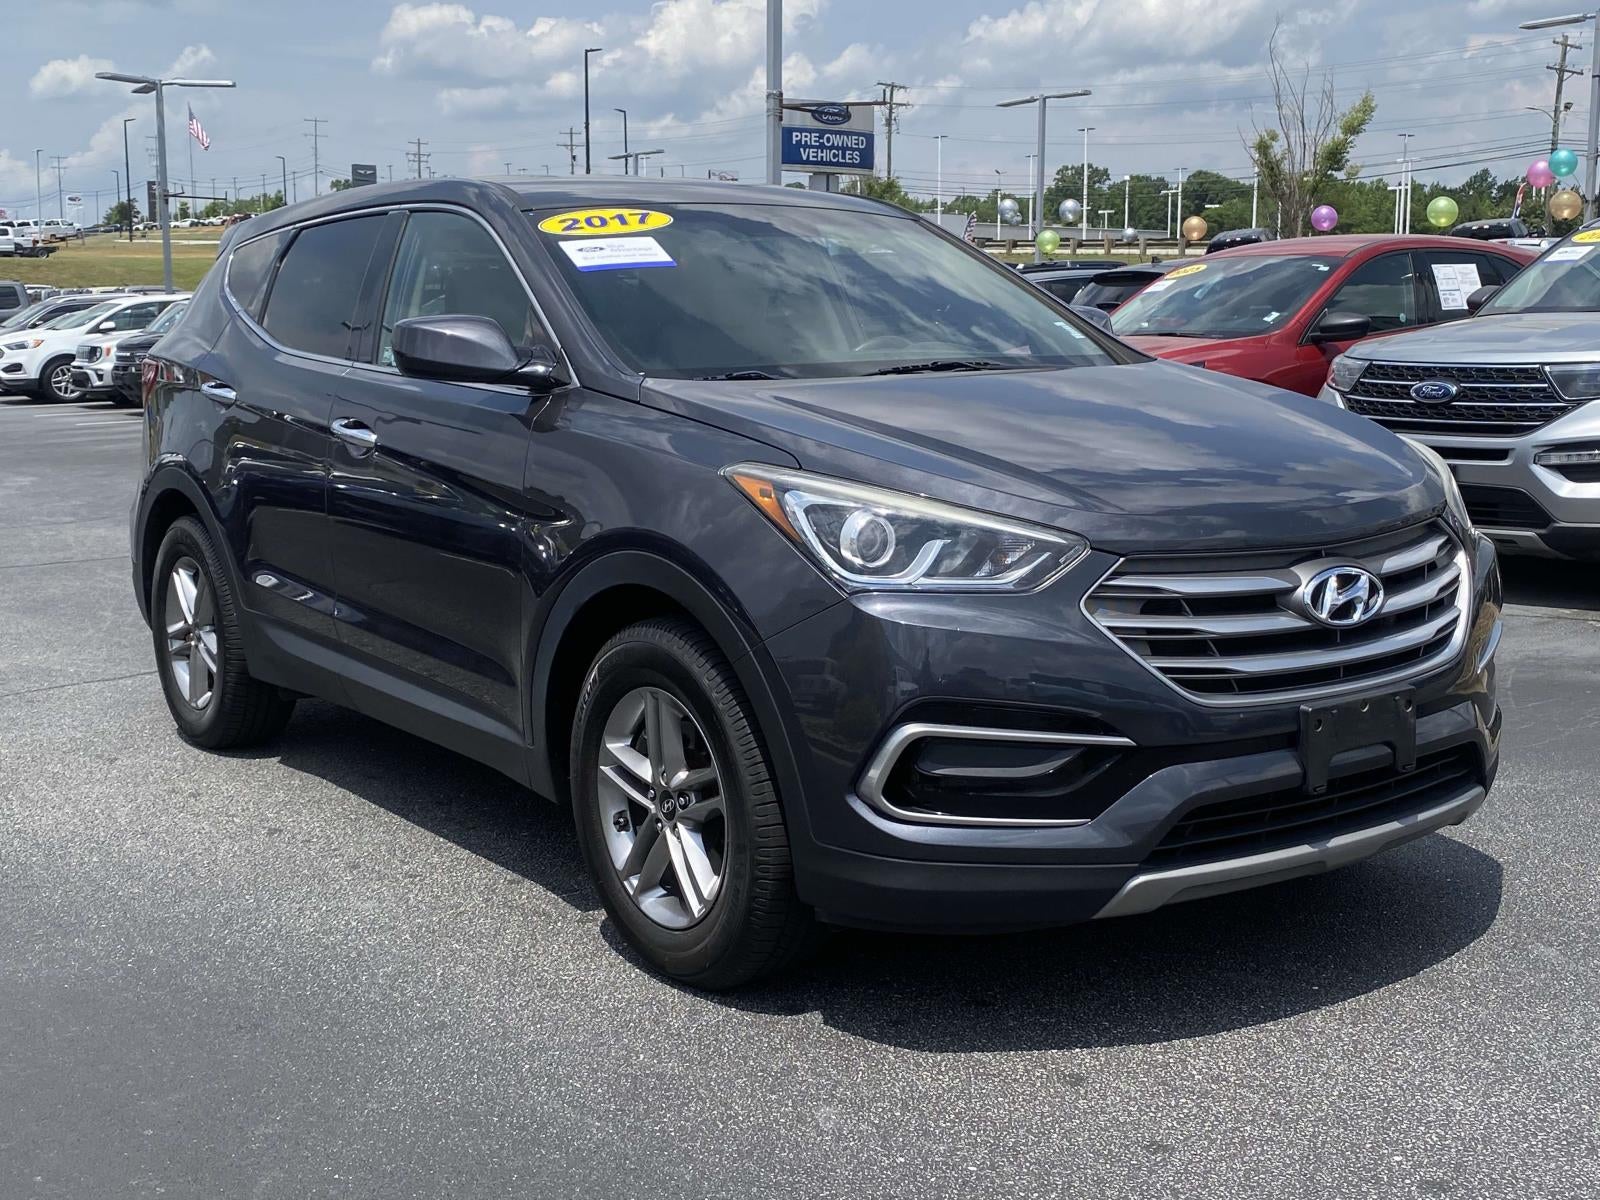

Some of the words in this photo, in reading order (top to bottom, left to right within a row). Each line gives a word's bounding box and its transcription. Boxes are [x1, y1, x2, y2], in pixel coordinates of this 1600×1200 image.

[792, 132, 866, 149] PRE-OWNED
[800, 148, 860, 163] VEHICLES
[558, 211, 651, 231] 2017
